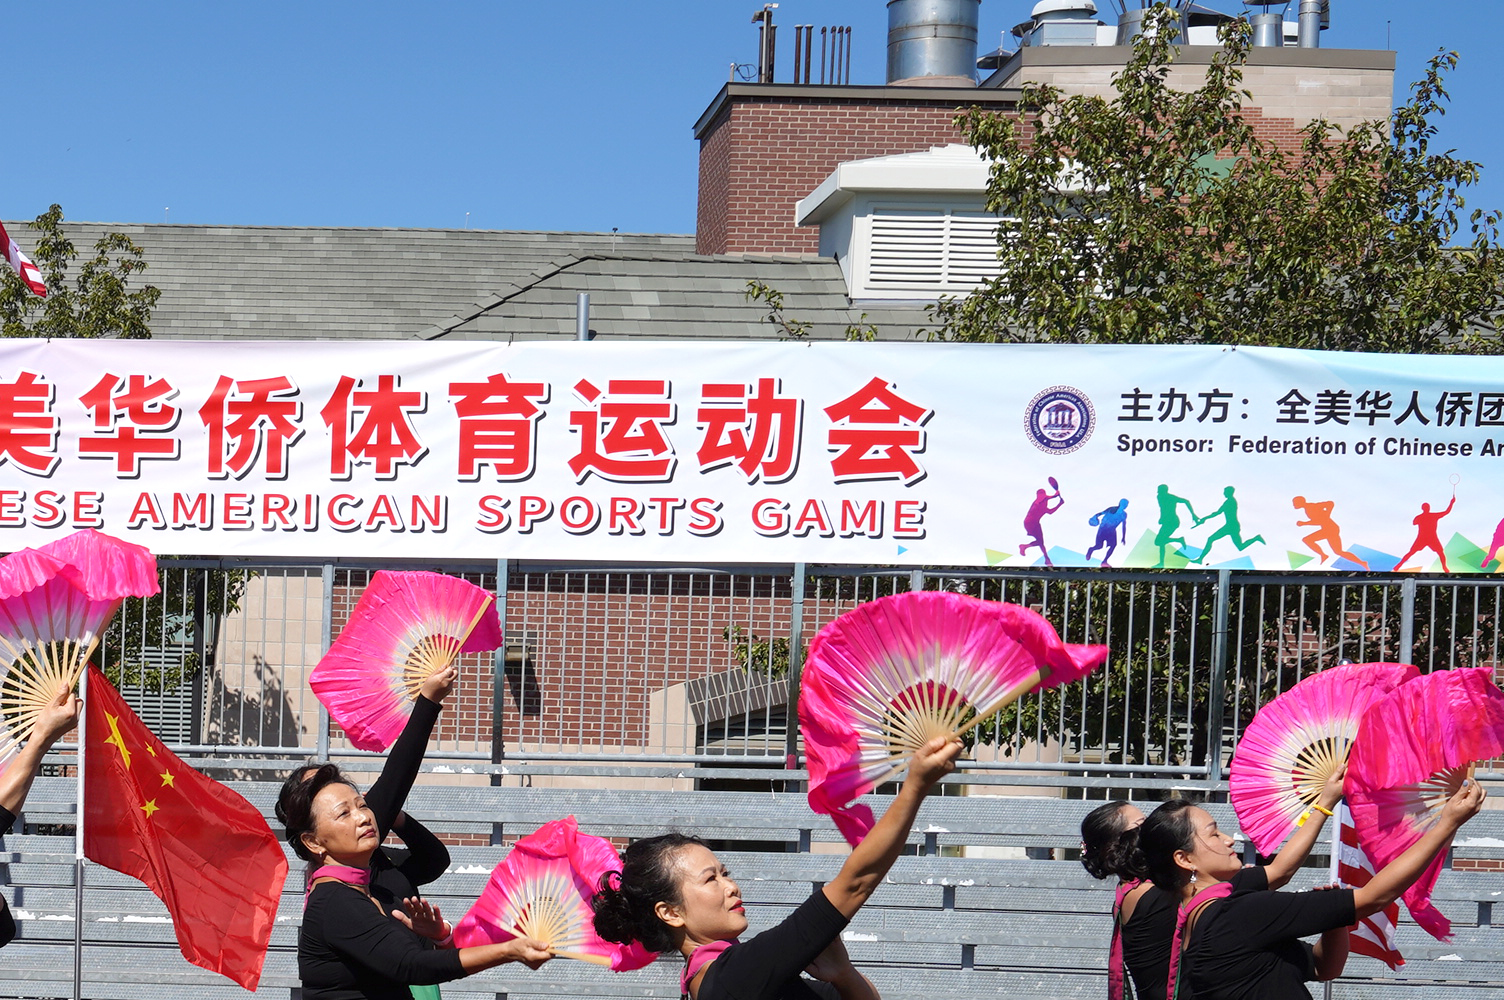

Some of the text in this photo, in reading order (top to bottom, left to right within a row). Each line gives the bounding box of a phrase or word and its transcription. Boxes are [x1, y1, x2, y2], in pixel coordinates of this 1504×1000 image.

[1116, 433, 1214, 457] Sponsor:
[1228, 434, 1347, 455] Federation
[1354, 437, 1377, 456] of
[1383, 437, 1473, 457] Chinese
[127, 491, 444, 528] AMERICAN
[476, 494, 719, 532] SPORTS
[750, 497, 923, 536] GAME
